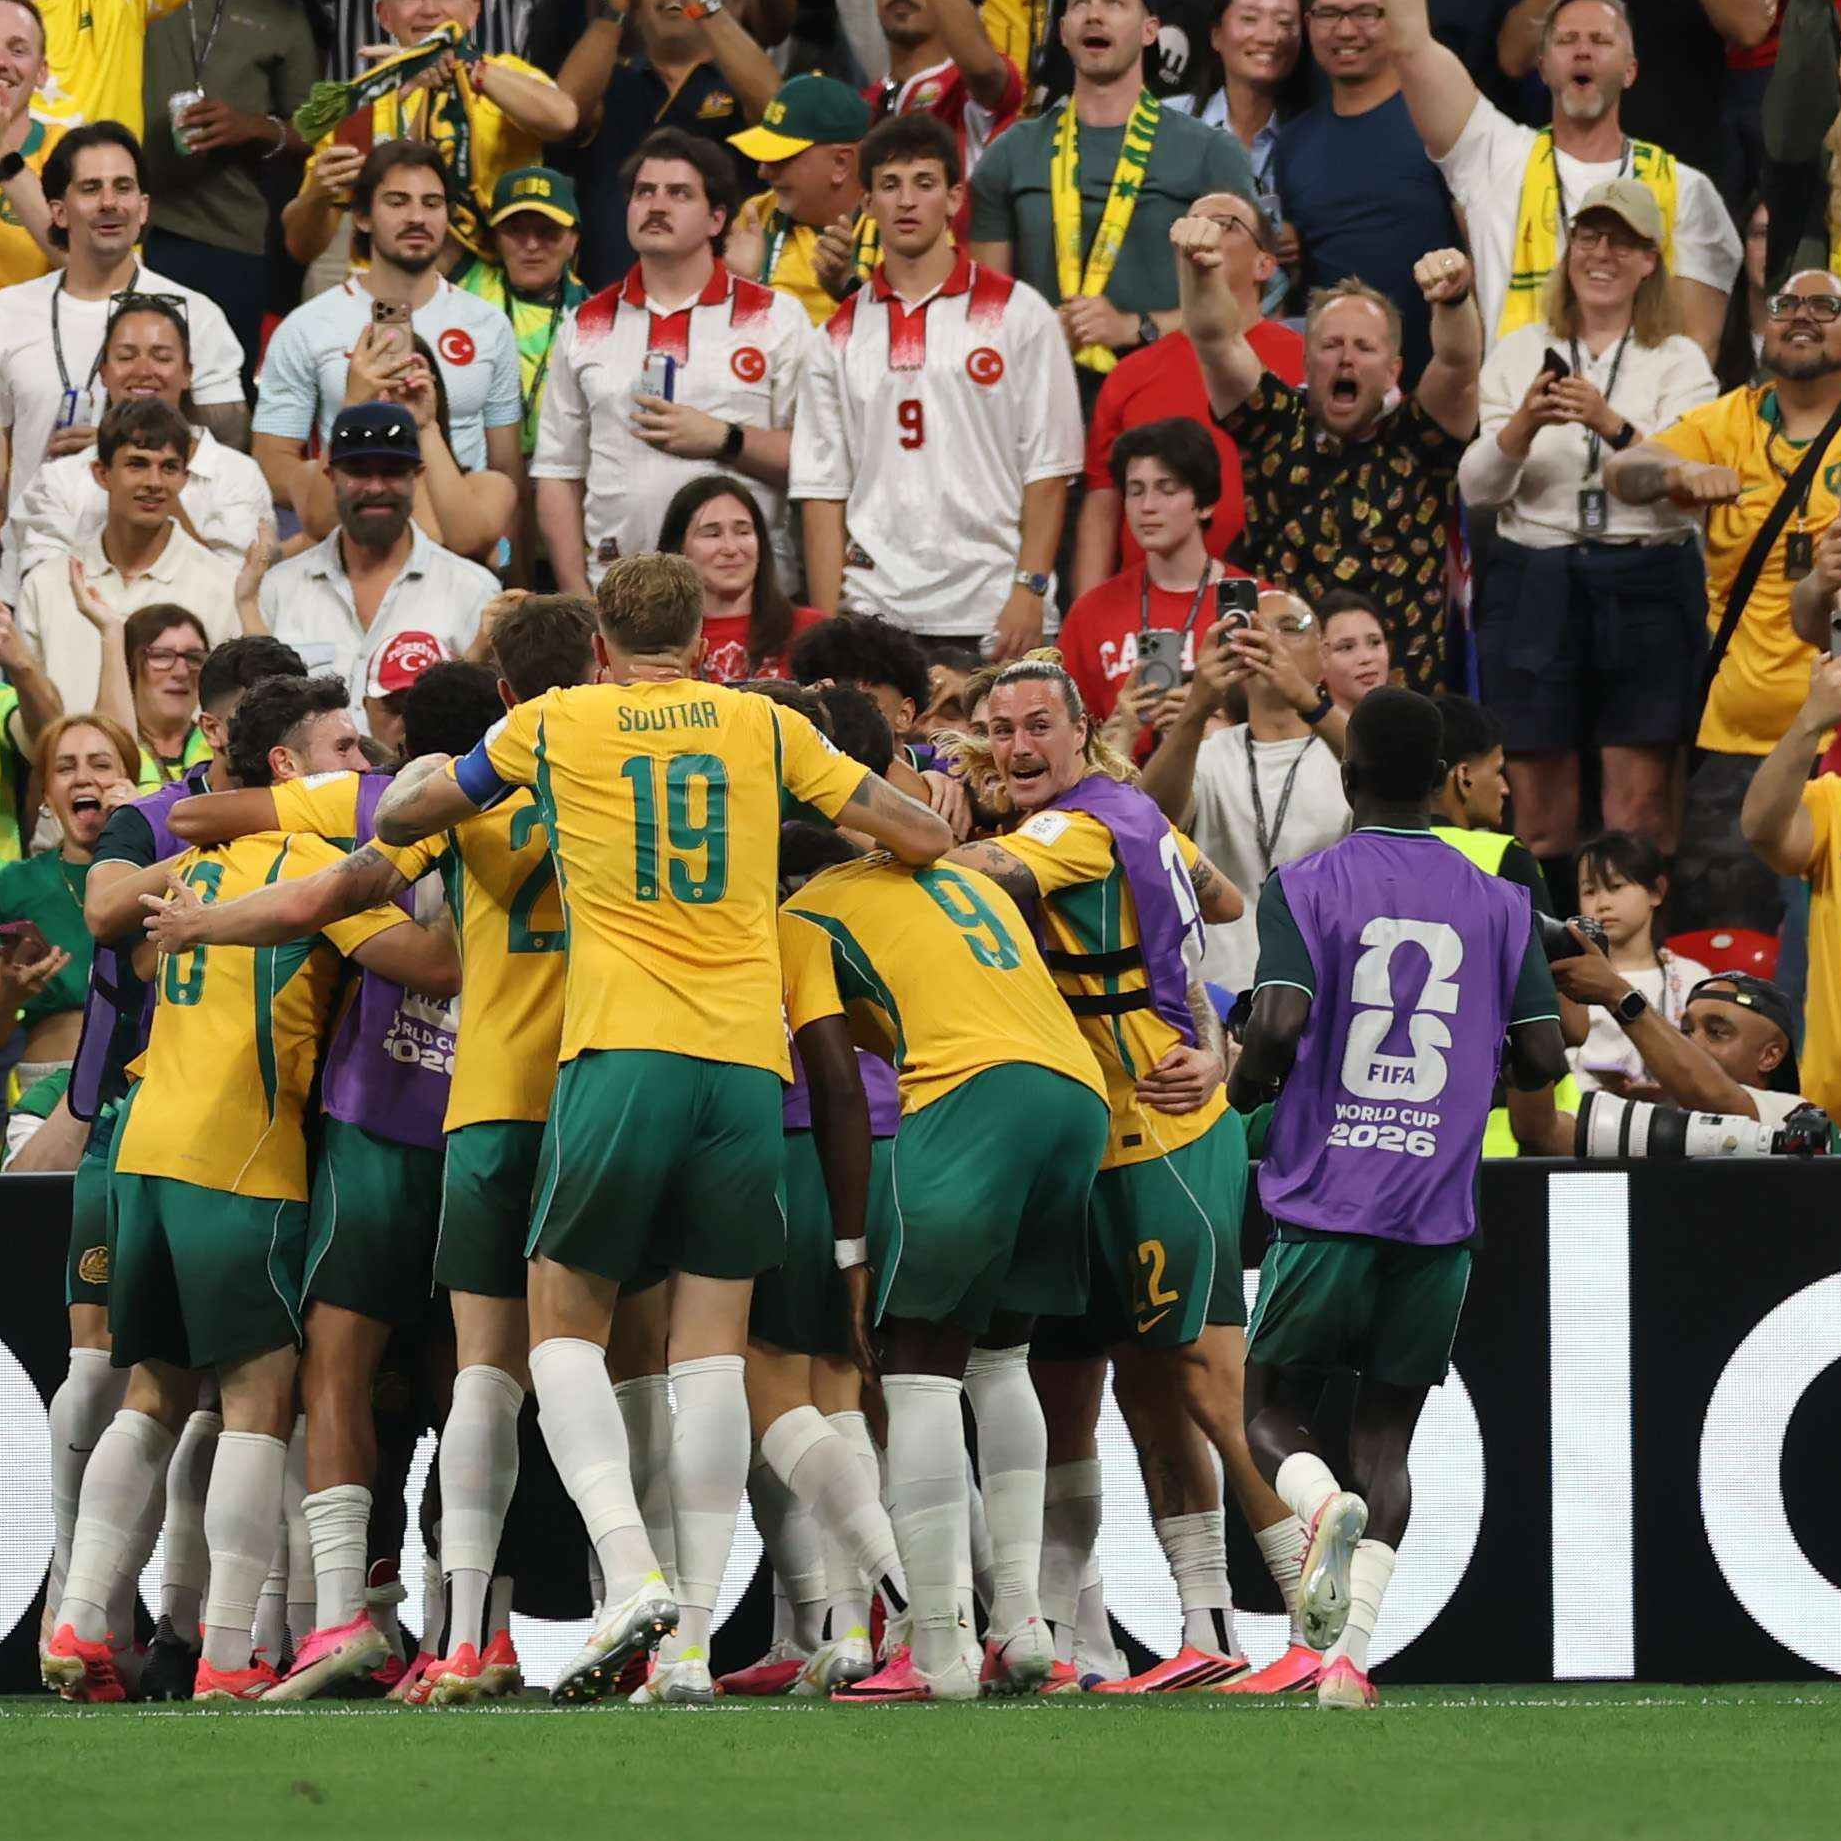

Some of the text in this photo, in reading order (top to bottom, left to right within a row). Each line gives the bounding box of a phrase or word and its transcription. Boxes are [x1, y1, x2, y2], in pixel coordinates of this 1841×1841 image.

[899, 400, 923, 450] 9
[618, 701, 721, 734] SOUTTAR
[621, 753, 731, 906] 19
[915, 868, 1021, 972] 9
[1367, 1062, 1416, 1085] FIFA
[1334, 1103, 1442, 1129] WORLD CUP
[1327, 1122, 1438, 1159] 2026
